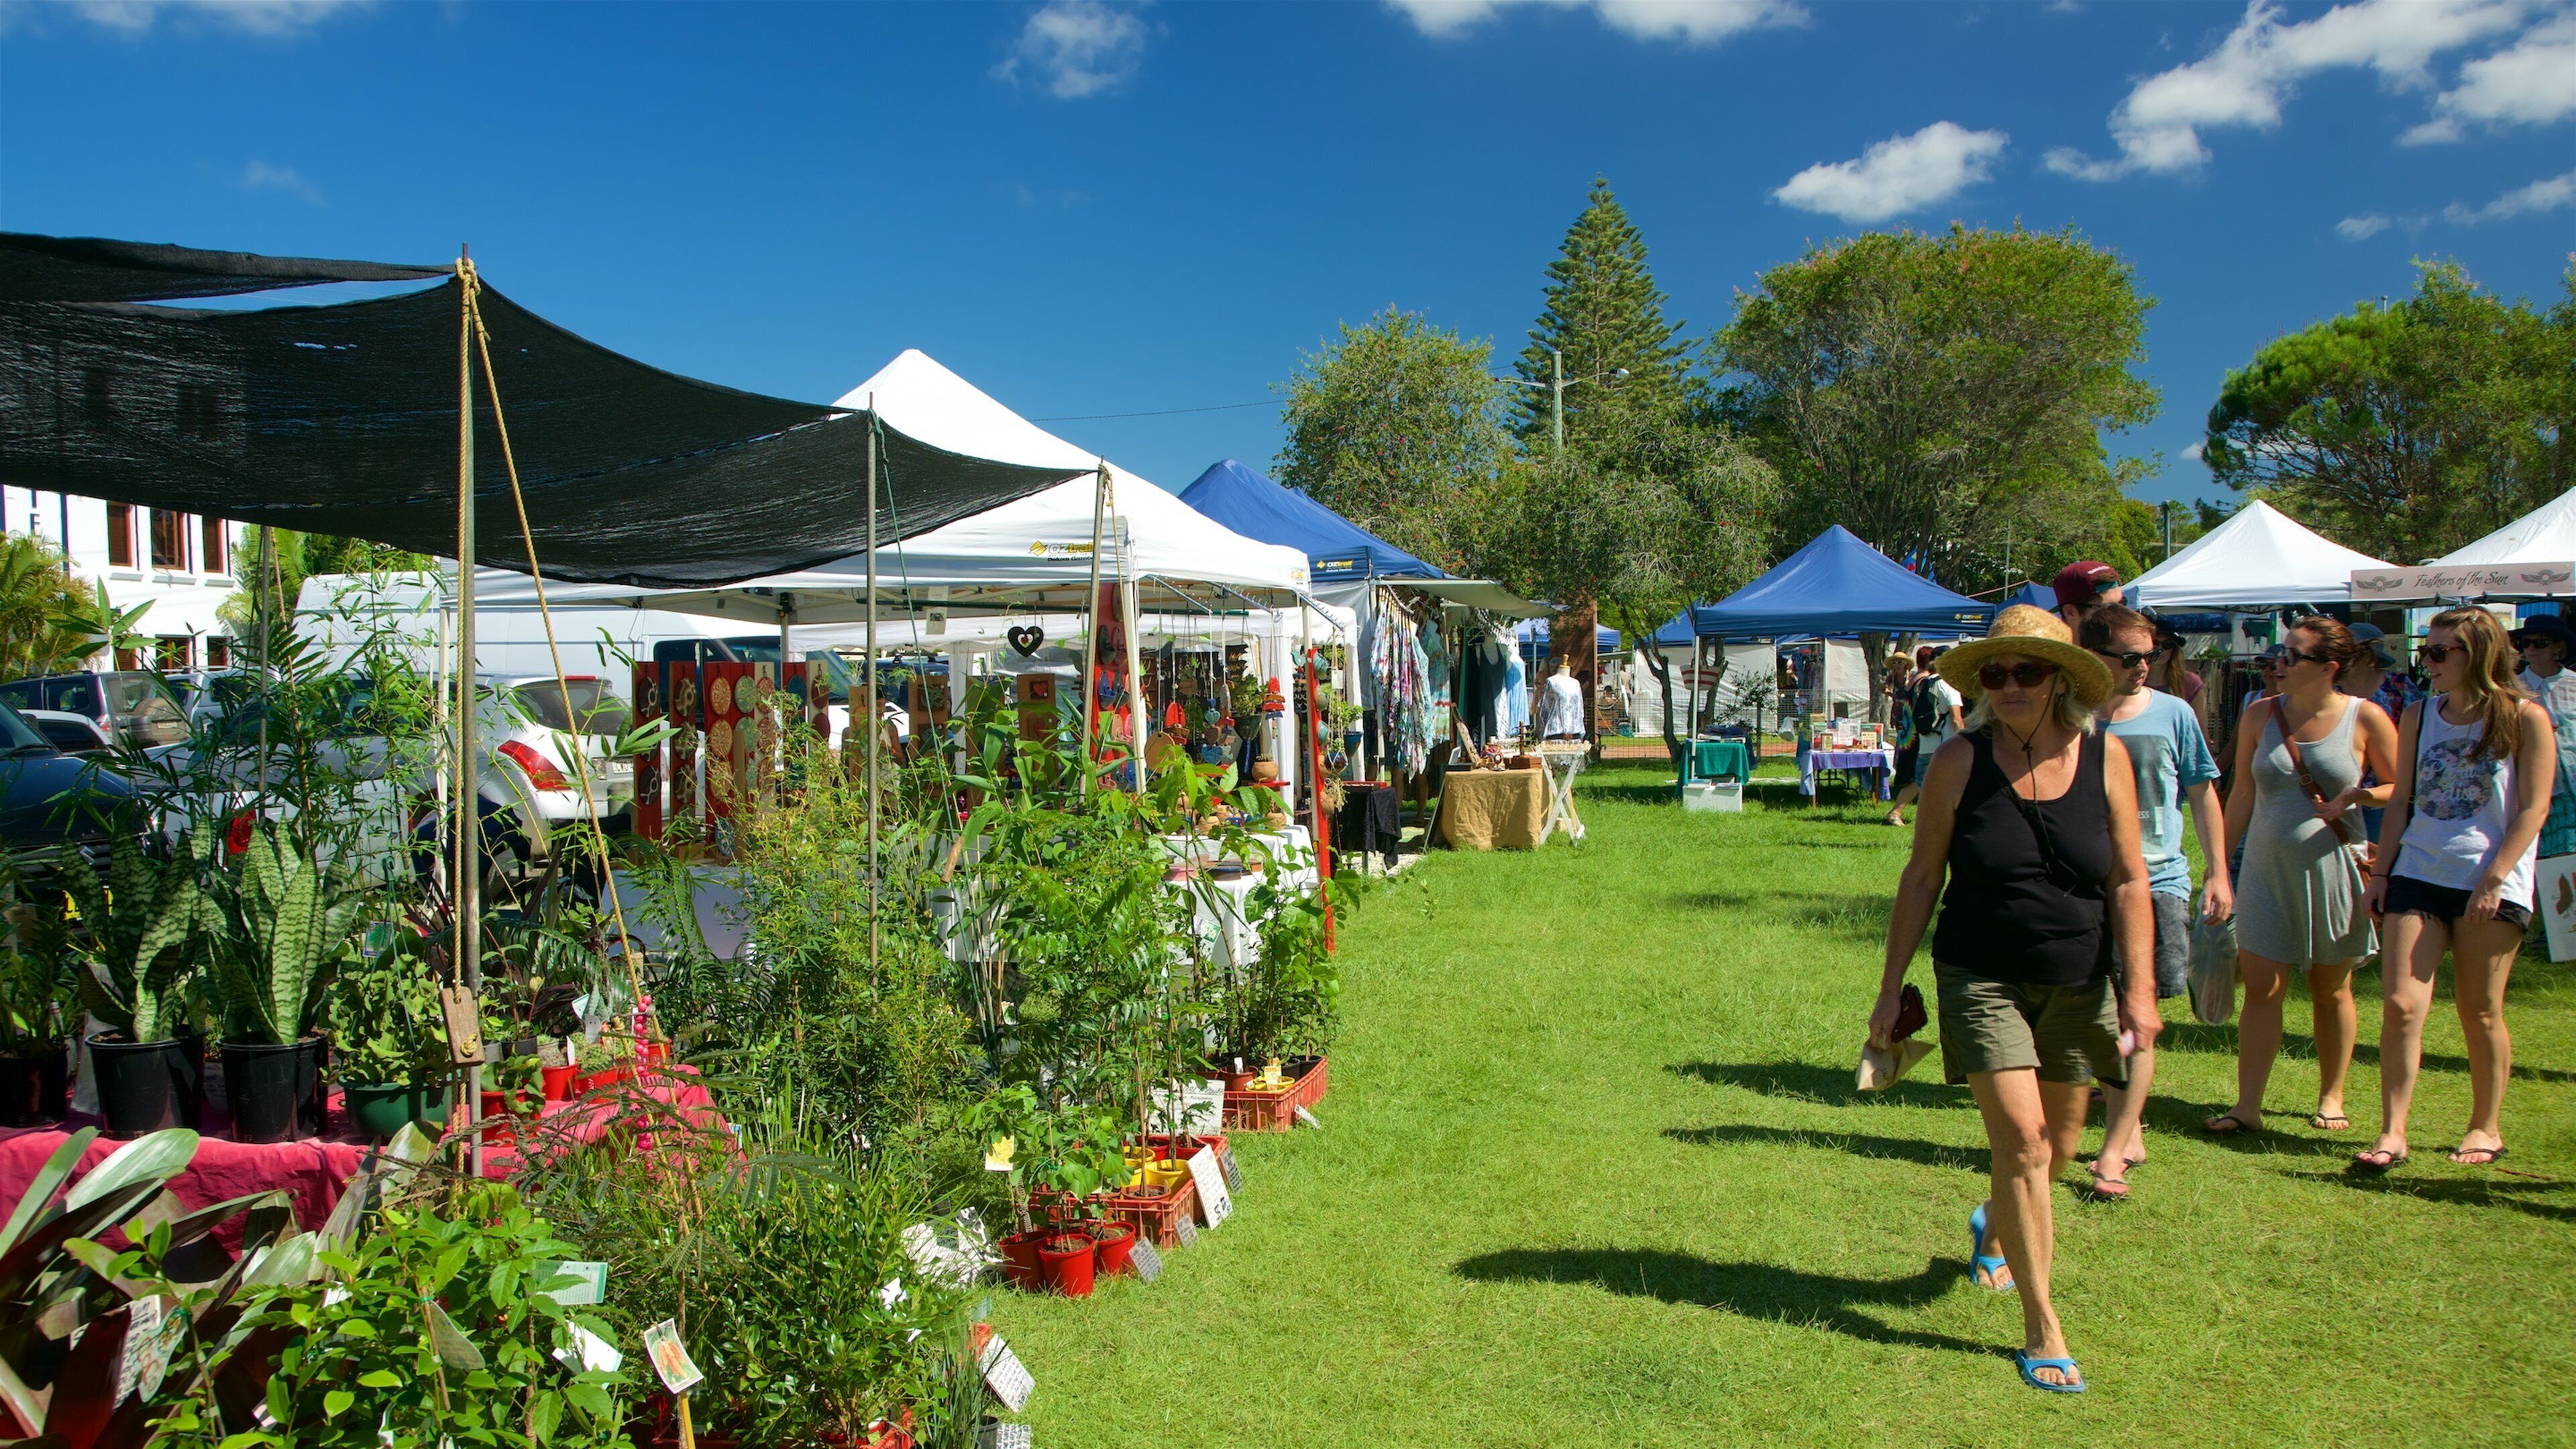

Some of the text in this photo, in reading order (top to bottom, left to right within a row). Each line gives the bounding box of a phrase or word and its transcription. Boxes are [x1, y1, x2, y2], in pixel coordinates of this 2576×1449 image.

[2413, 571, 2509, 590] Feathers of the Sun
